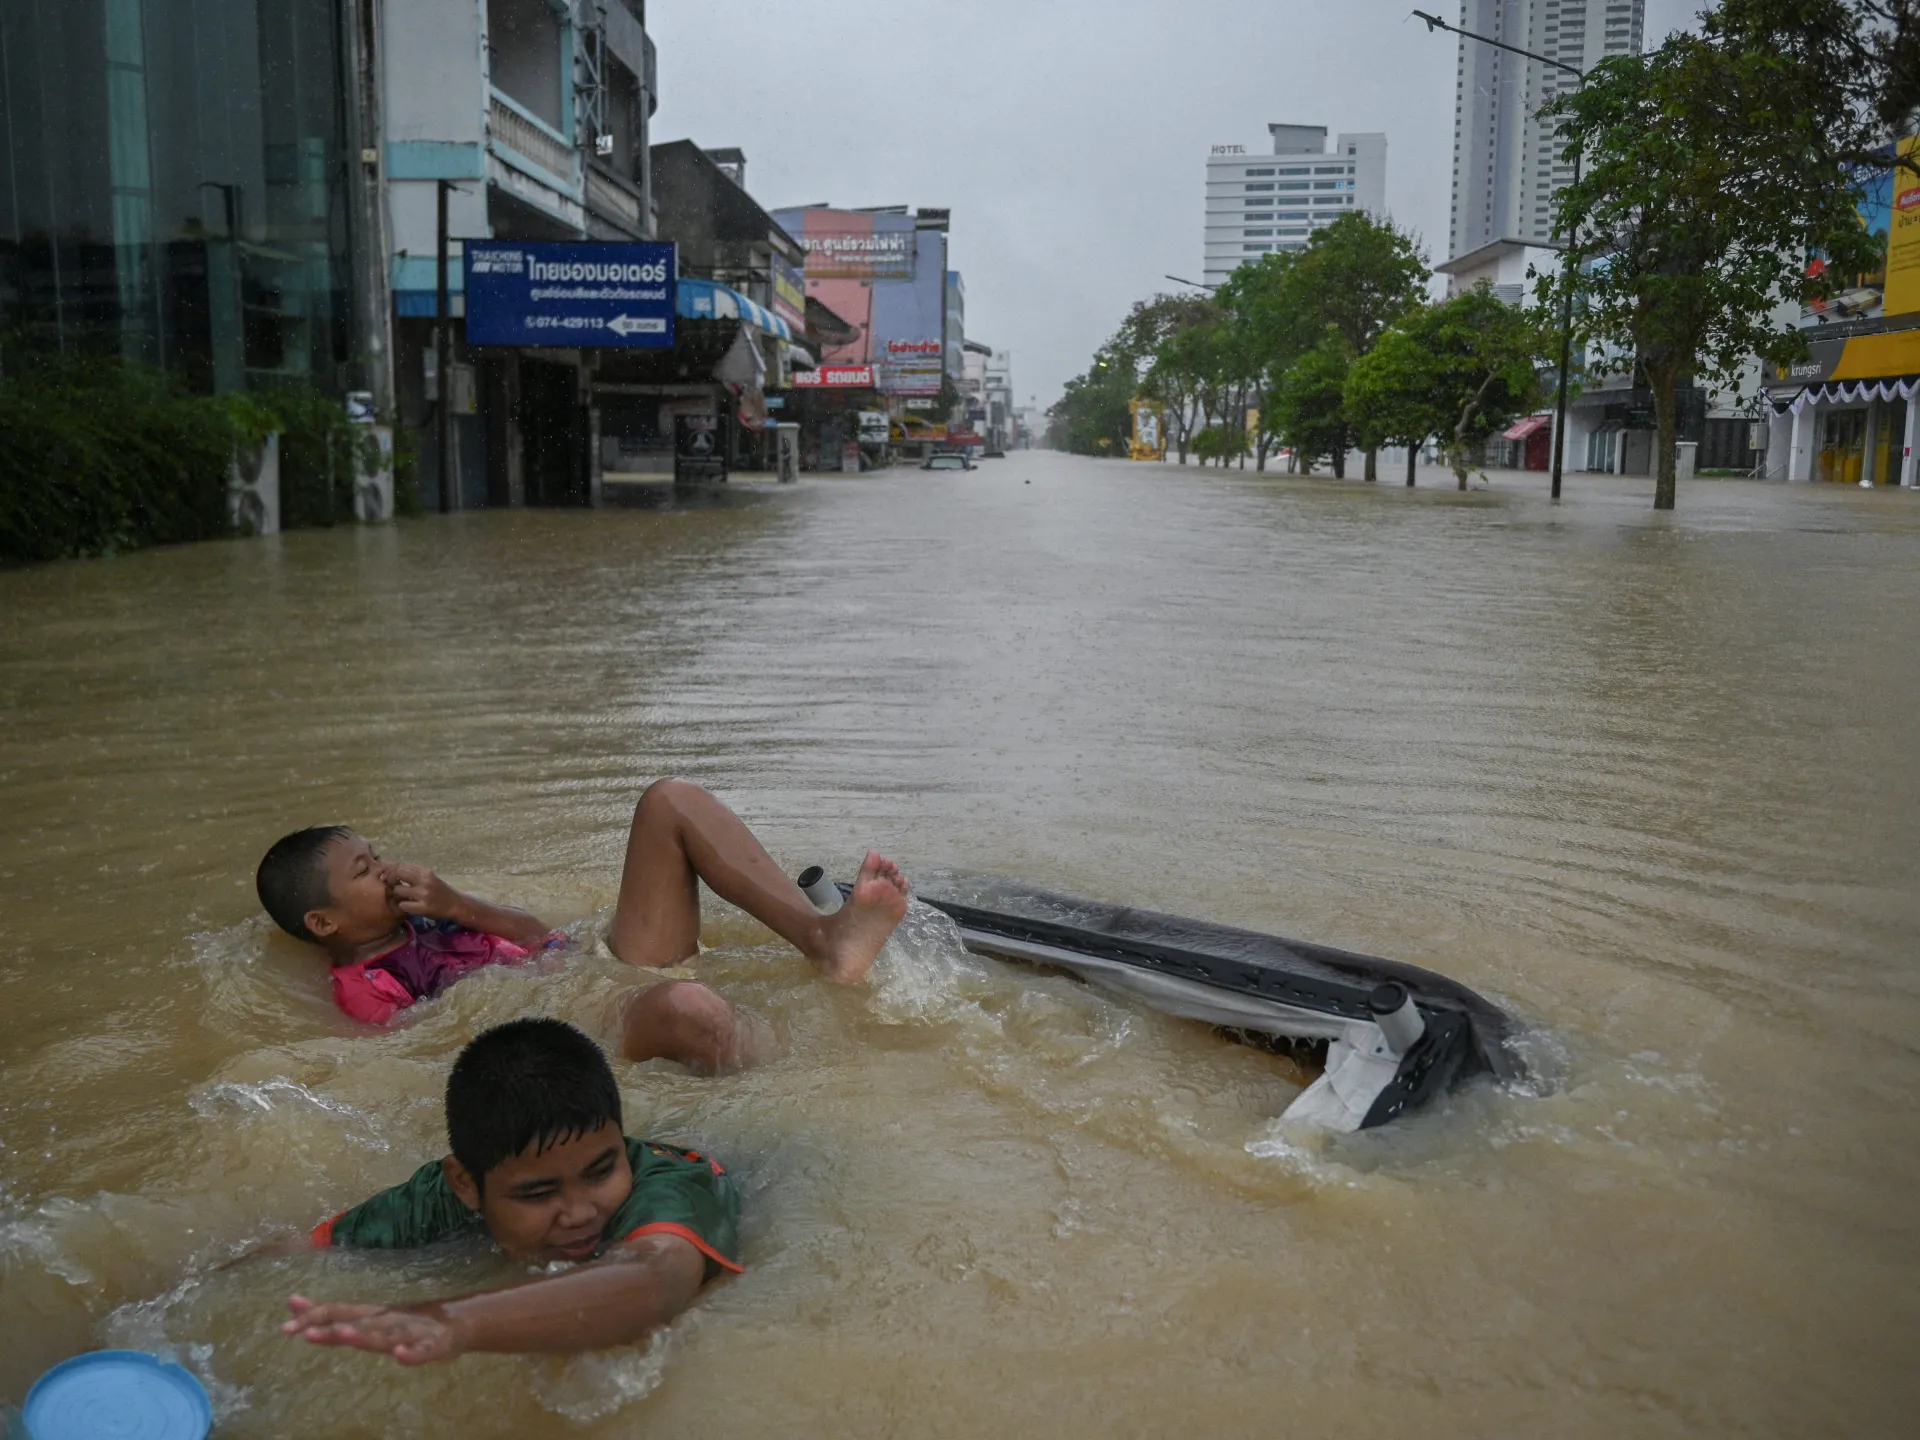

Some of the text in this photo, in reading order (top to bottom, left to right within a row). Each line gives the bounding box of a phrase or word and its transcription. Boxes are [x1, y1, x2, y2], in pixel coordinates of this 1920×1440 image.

[1211, 145, 1245, 154] HOTEL
[795, 366, 822, 384] แอร์
[826, 366, 870, 384] รถยนต์
[1791, 360, 1822, 378] krungsri
